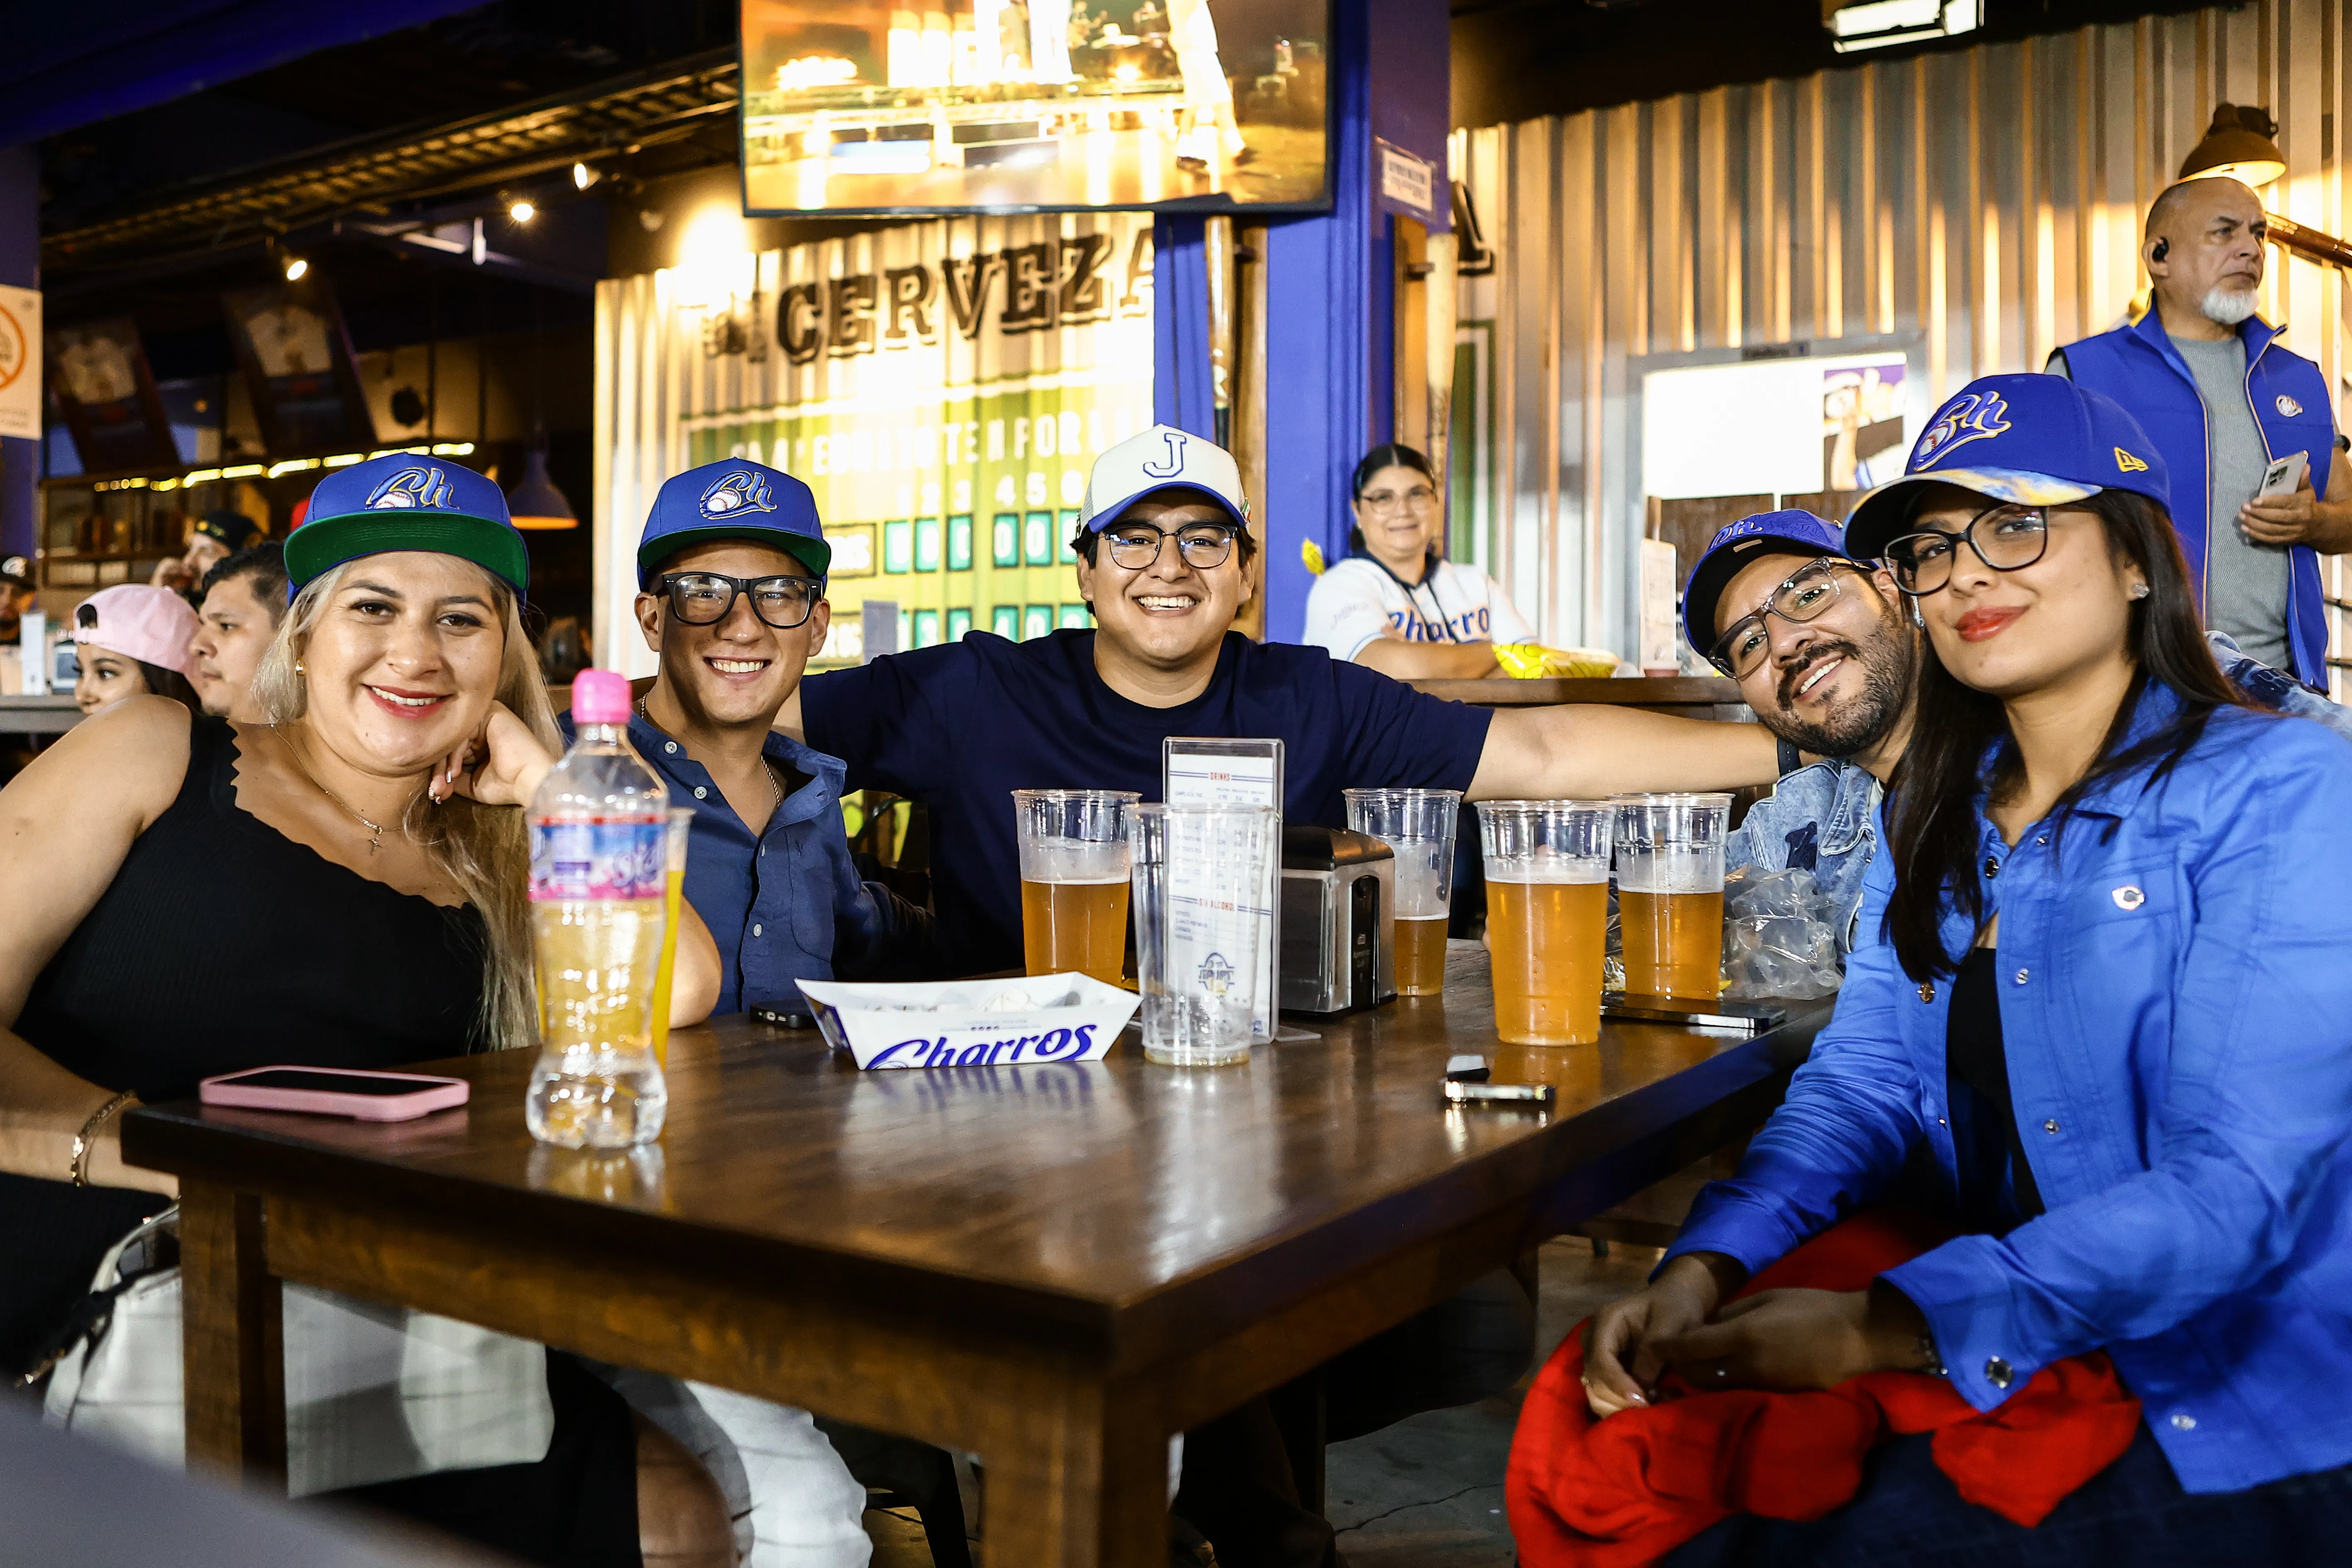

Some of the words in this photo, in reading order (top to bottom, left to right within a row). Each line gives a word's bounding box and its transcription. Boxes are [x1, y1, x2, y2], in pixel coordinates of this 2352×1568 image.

[1143, 432, 1187, 478] J
[995, 475, 1016, 507] 4
[1026, 472, 1047, 506] 5
[865, 1023, 1097, 1069] Charros
